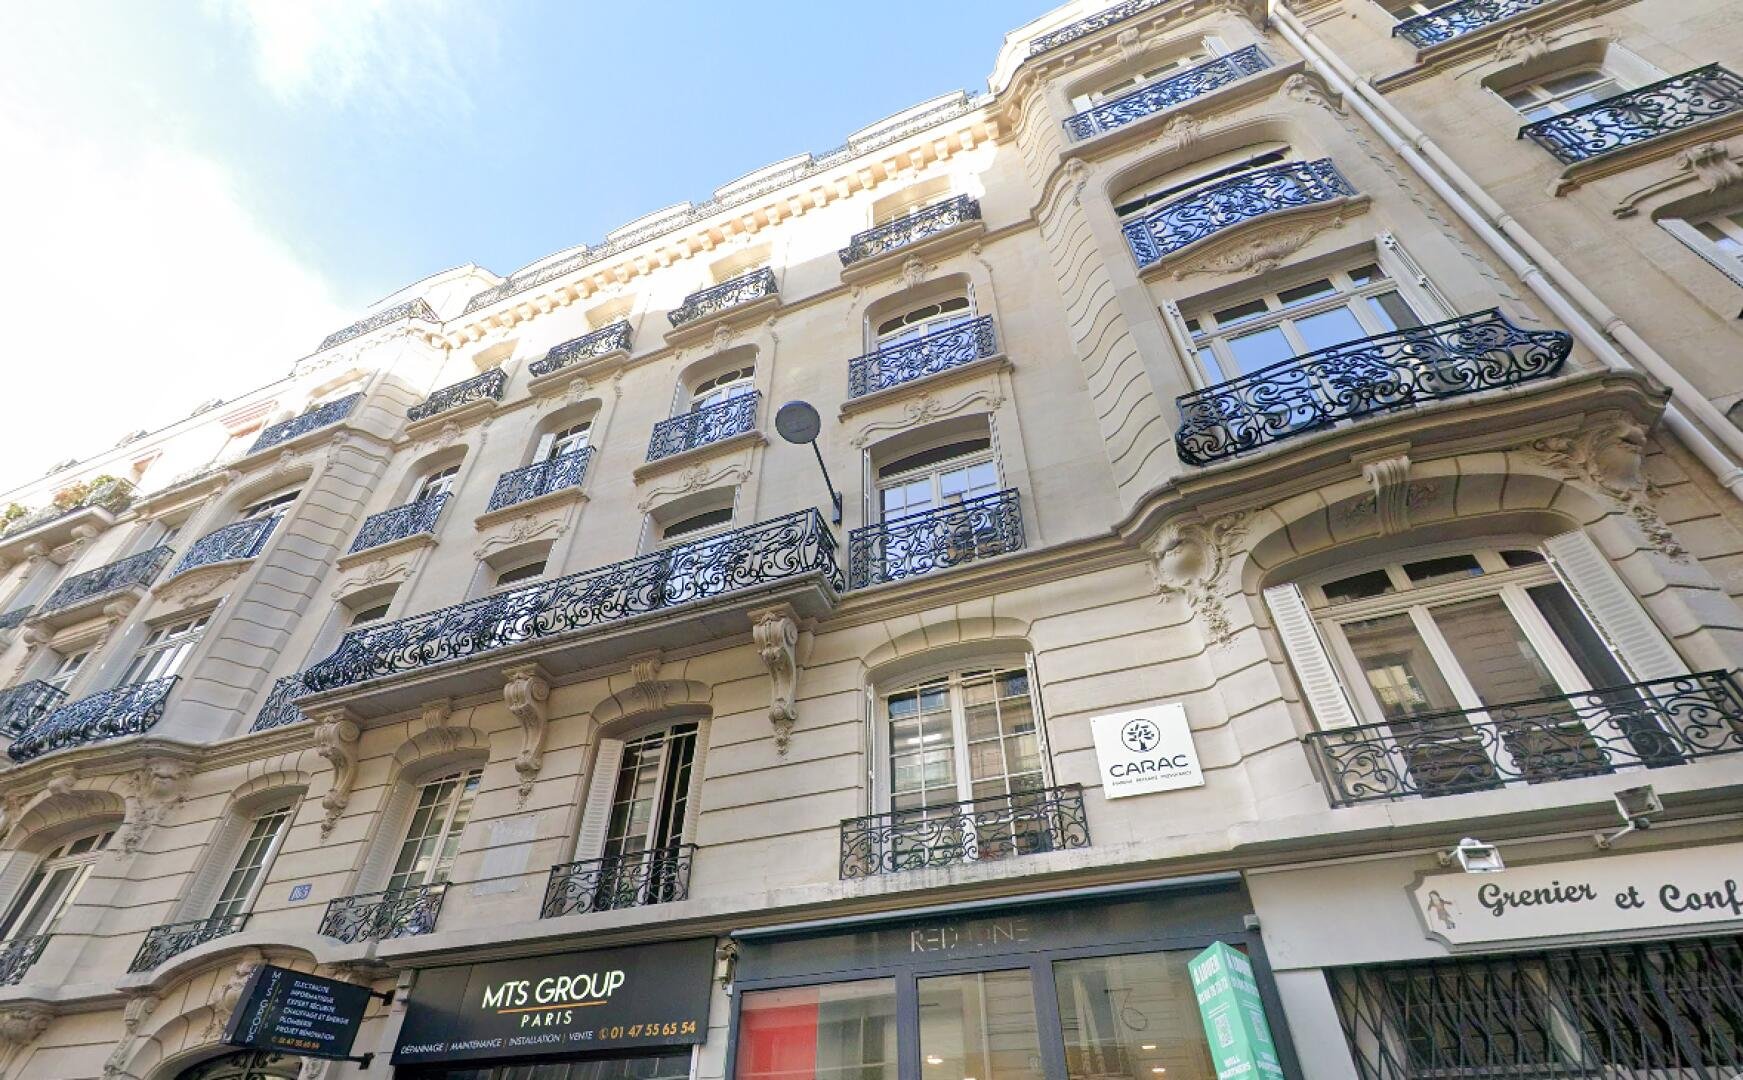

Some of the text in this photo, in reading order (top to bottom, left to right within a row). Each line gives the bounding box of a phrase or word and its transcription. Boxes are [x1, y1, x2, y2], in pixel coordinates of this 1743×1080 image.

[1109, 754, 1189, 778] CARAC
[1478, 880, 1597, 917] Grenier
[1615, 886, 1645, 909] et
[910, 926, 959, 953] RED
[481, 969, 626, 1009] MTS GROUP
[520, 1009, 573, 1028] PARIS
[508, 1033, 561, 1047] INSTALLATION
[568, 1030, 594, 1041] VENTE
[610, 1026, 624, 1040] 01
[627, 1023, 645, 1038] 47
[645, 1023, 661, 1037] 55
[662, 1021, 678, 1037] 65
[681, 1020, 697, 1035] 54
